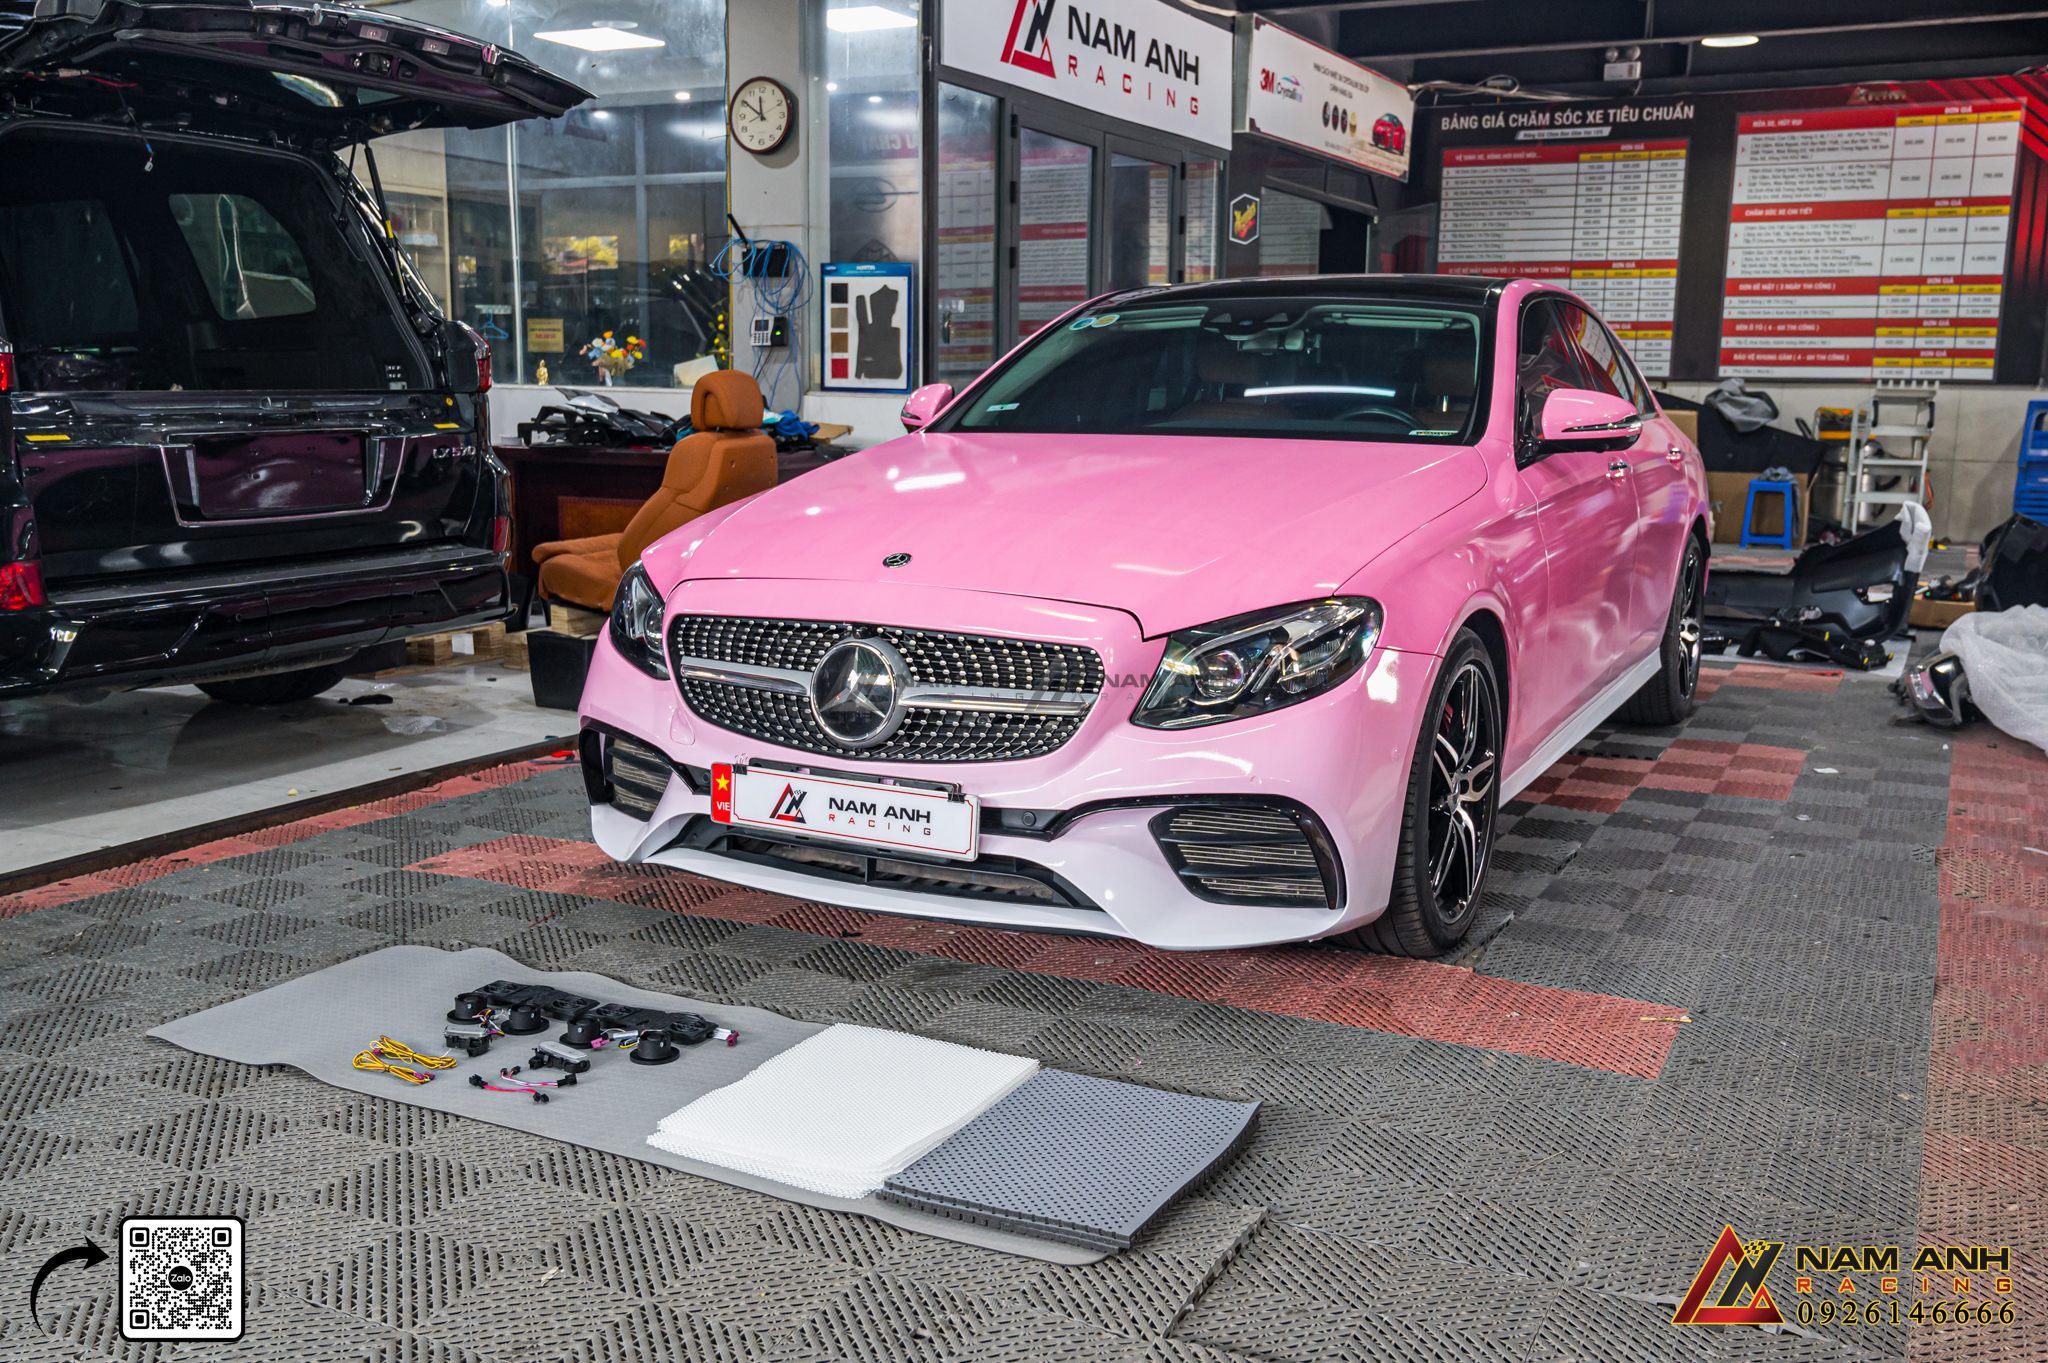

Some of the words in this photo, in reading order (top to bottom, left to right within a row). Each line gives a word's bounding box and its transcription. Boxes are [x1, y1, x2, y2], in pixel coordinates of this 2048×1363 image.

[1068, 5, 1136, 63] NAM
[1145, 38, 1199, 86] ANH
[1068, 54, 1199, 115] RACING
[1260, 68, 1275, 93] 3M
[1441, 112, 1479, 130] BẢNG
[1482, 110, 1506, 129] GIÁ
[1508, 109, 1550, 127] CHĂM
[1554, 107, 1583, 125] SÓC
[1586, 109, 1604, 124] XE
[1607, 104, 1640, 123] TIÊU
[1642, 100, 1695, 122] CHUẨN
[716, 801, 731, 811] VIE
[829, 797, 877, 816] NAM
[883, 806, 931, 824] ANH
[829, 813, 931, 836] RACING
